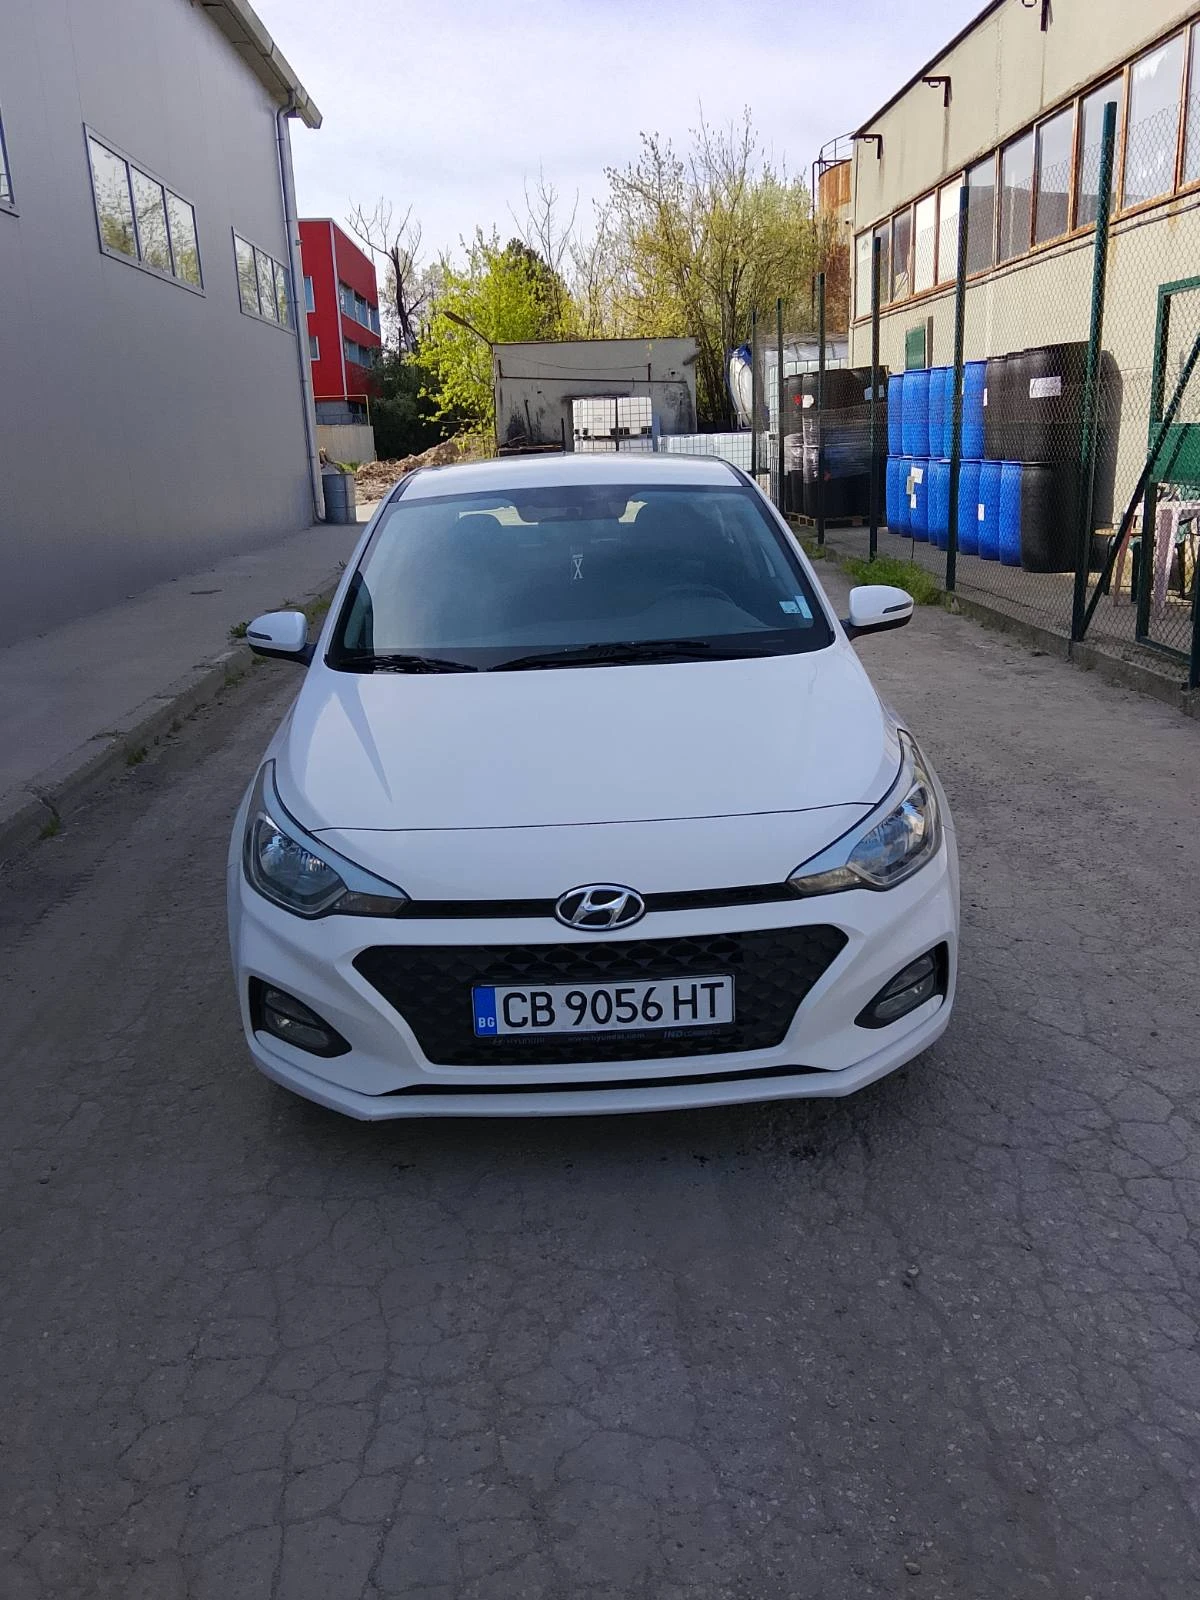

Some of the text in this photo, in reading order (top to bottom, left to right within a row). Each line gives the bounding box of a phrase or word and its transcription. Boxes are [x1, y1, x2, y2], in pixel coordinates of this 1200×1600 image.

[502, 982, 725, 1028] CB 9056 HT
[478, 1017, 496, 1028] BG
